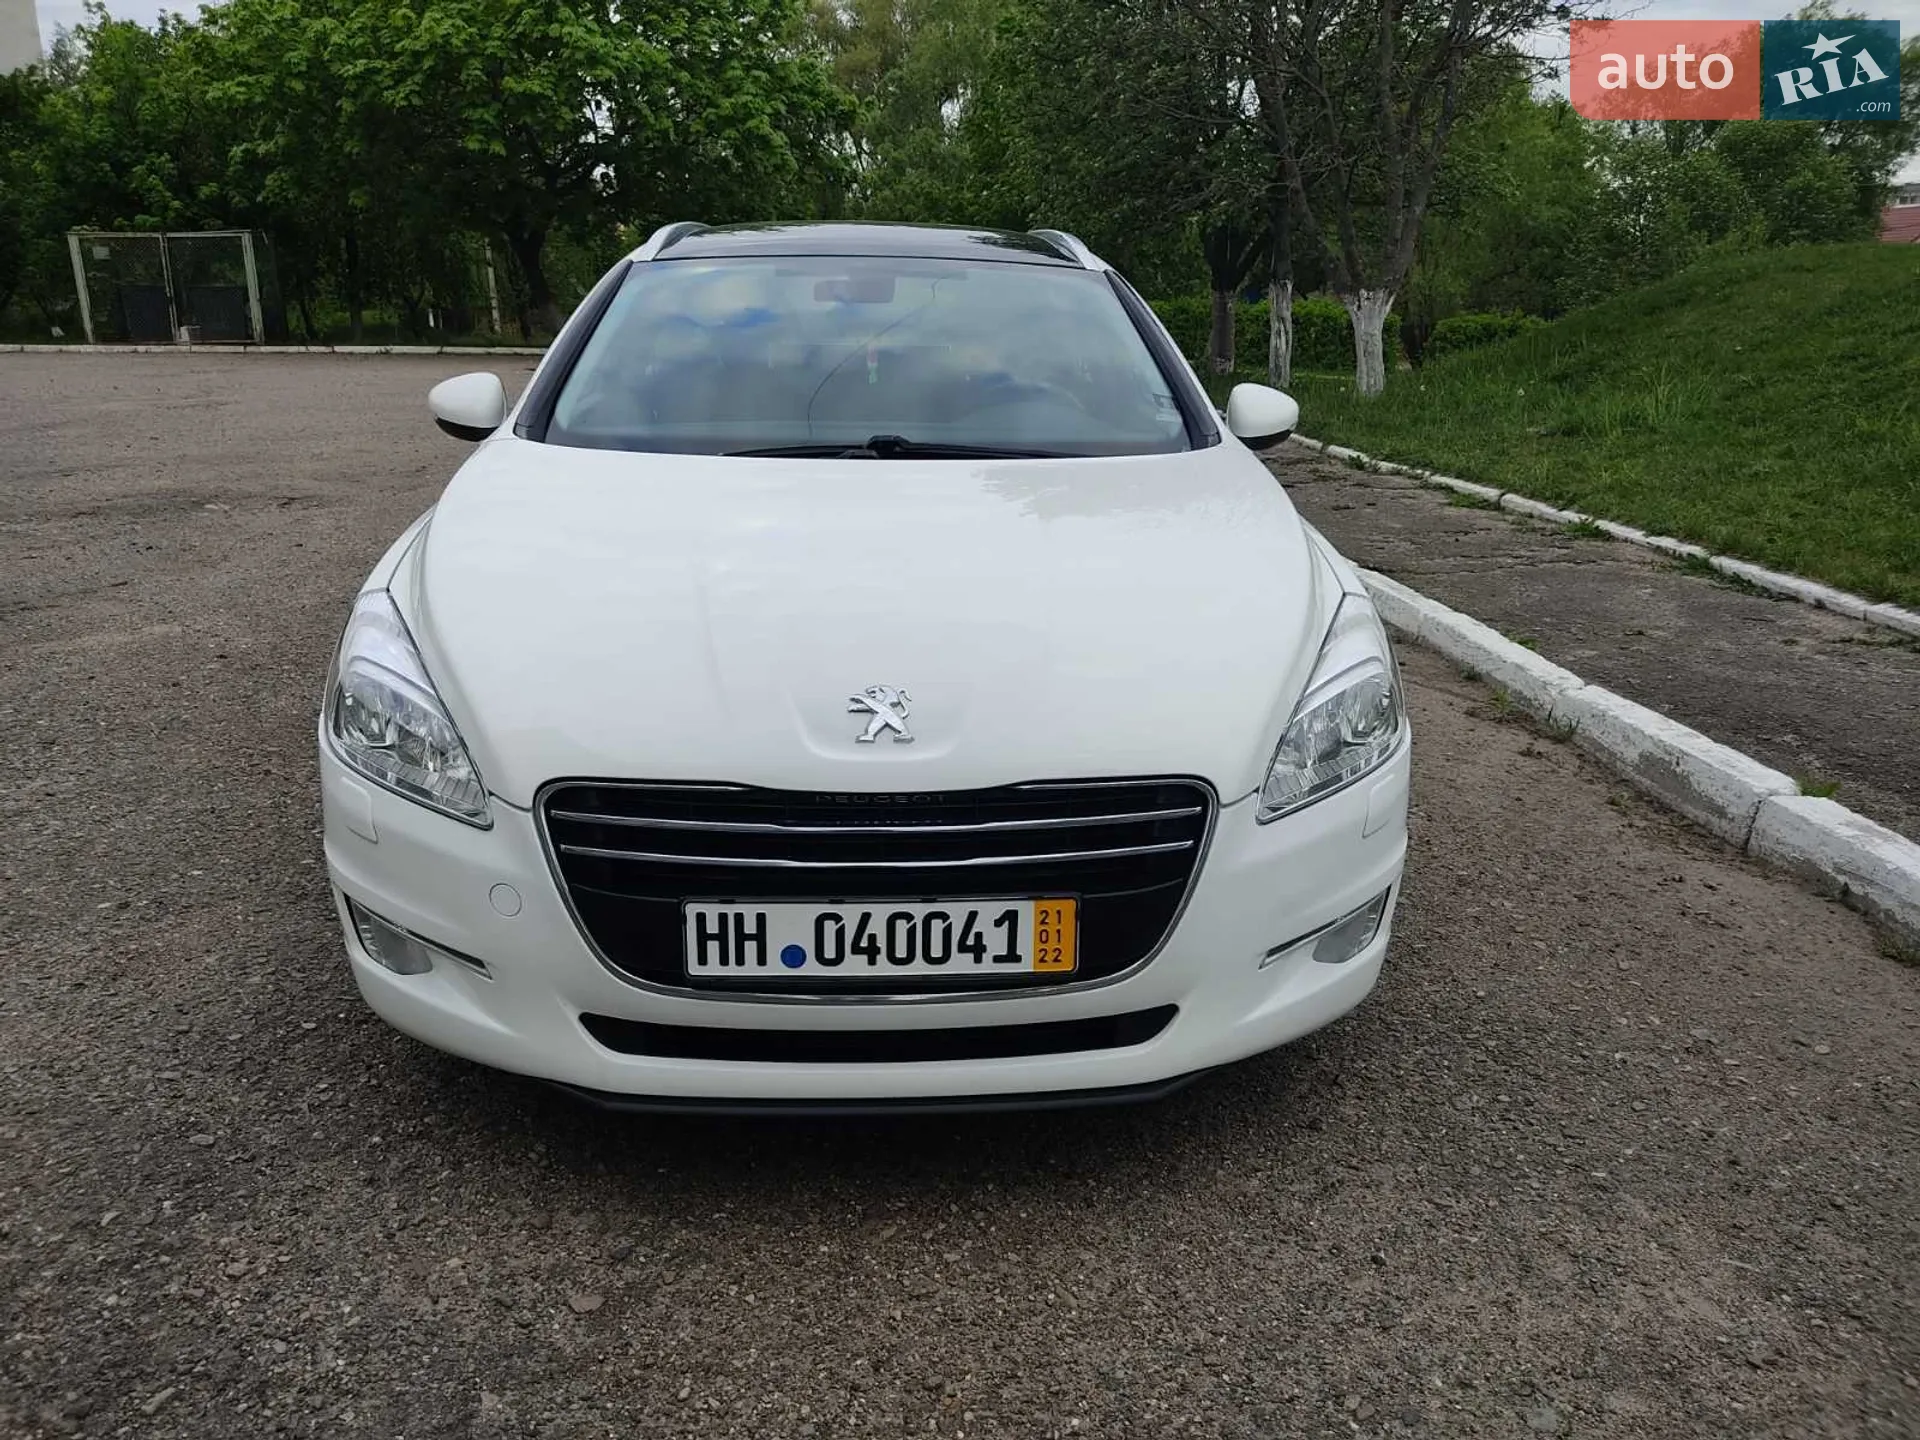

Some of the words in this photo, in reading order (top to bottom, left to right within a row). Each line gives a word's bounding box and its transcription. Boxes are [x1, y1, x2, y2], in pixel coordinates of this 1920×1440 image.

[1039, 909, 1061, 925] 21
[695, 911, 767, 967] HH
[813, 908, 1022, 967] 040041
[1039, 928, 1061, 944] 01
[1038, 947, 1062, 963] 22
